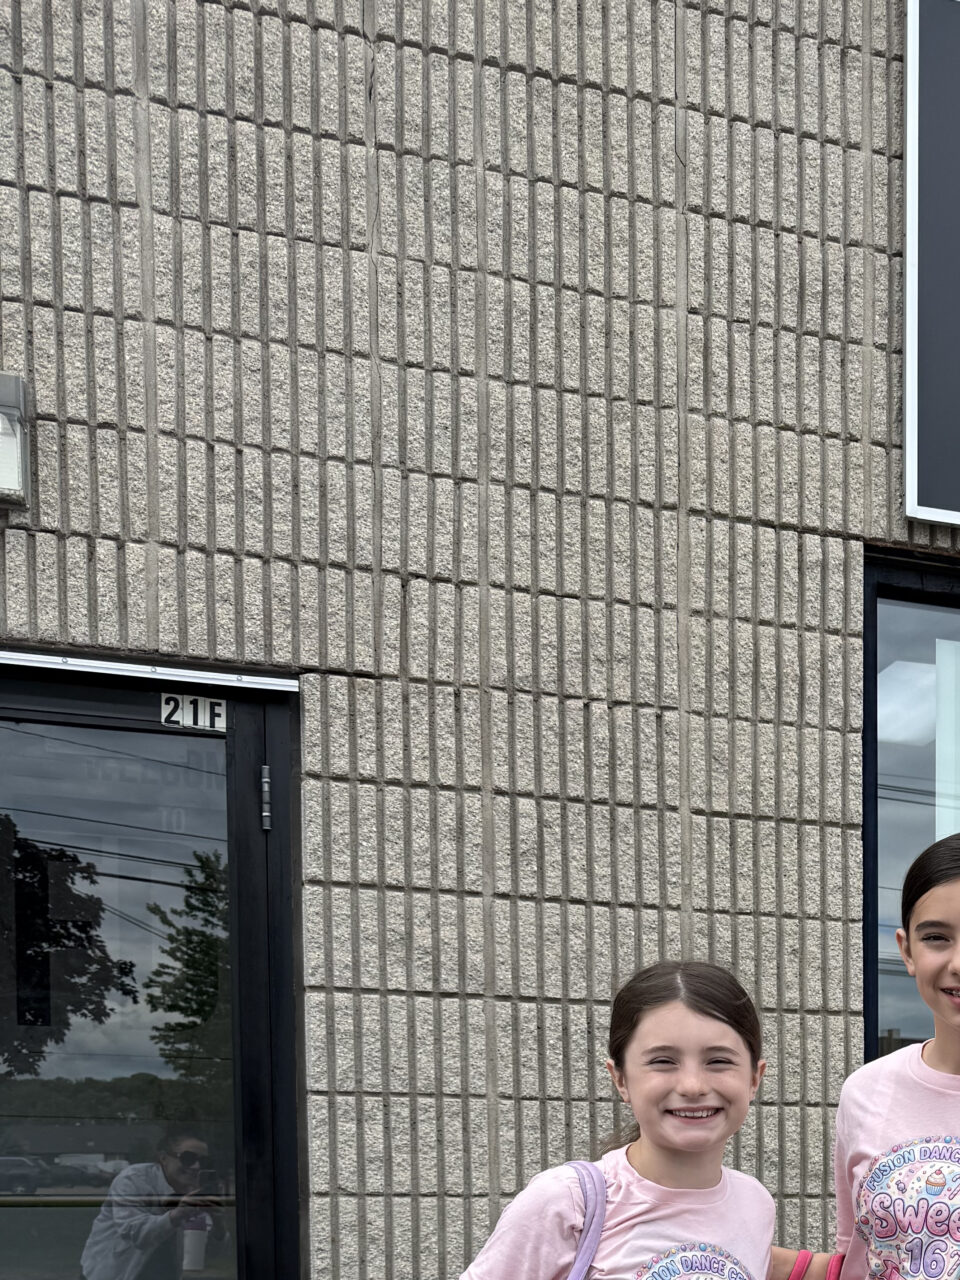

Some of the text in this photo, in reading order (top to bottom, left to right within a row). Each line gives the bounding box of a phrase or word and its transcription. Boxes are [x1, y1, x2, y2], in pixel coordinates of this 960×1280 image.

[164, 696, 222, 728] 21F
[865, 1149, 916, 1192] FUSION
[680, 1254, 726, 1276] DANCE
[905, 1237, 948, 1278] 16
